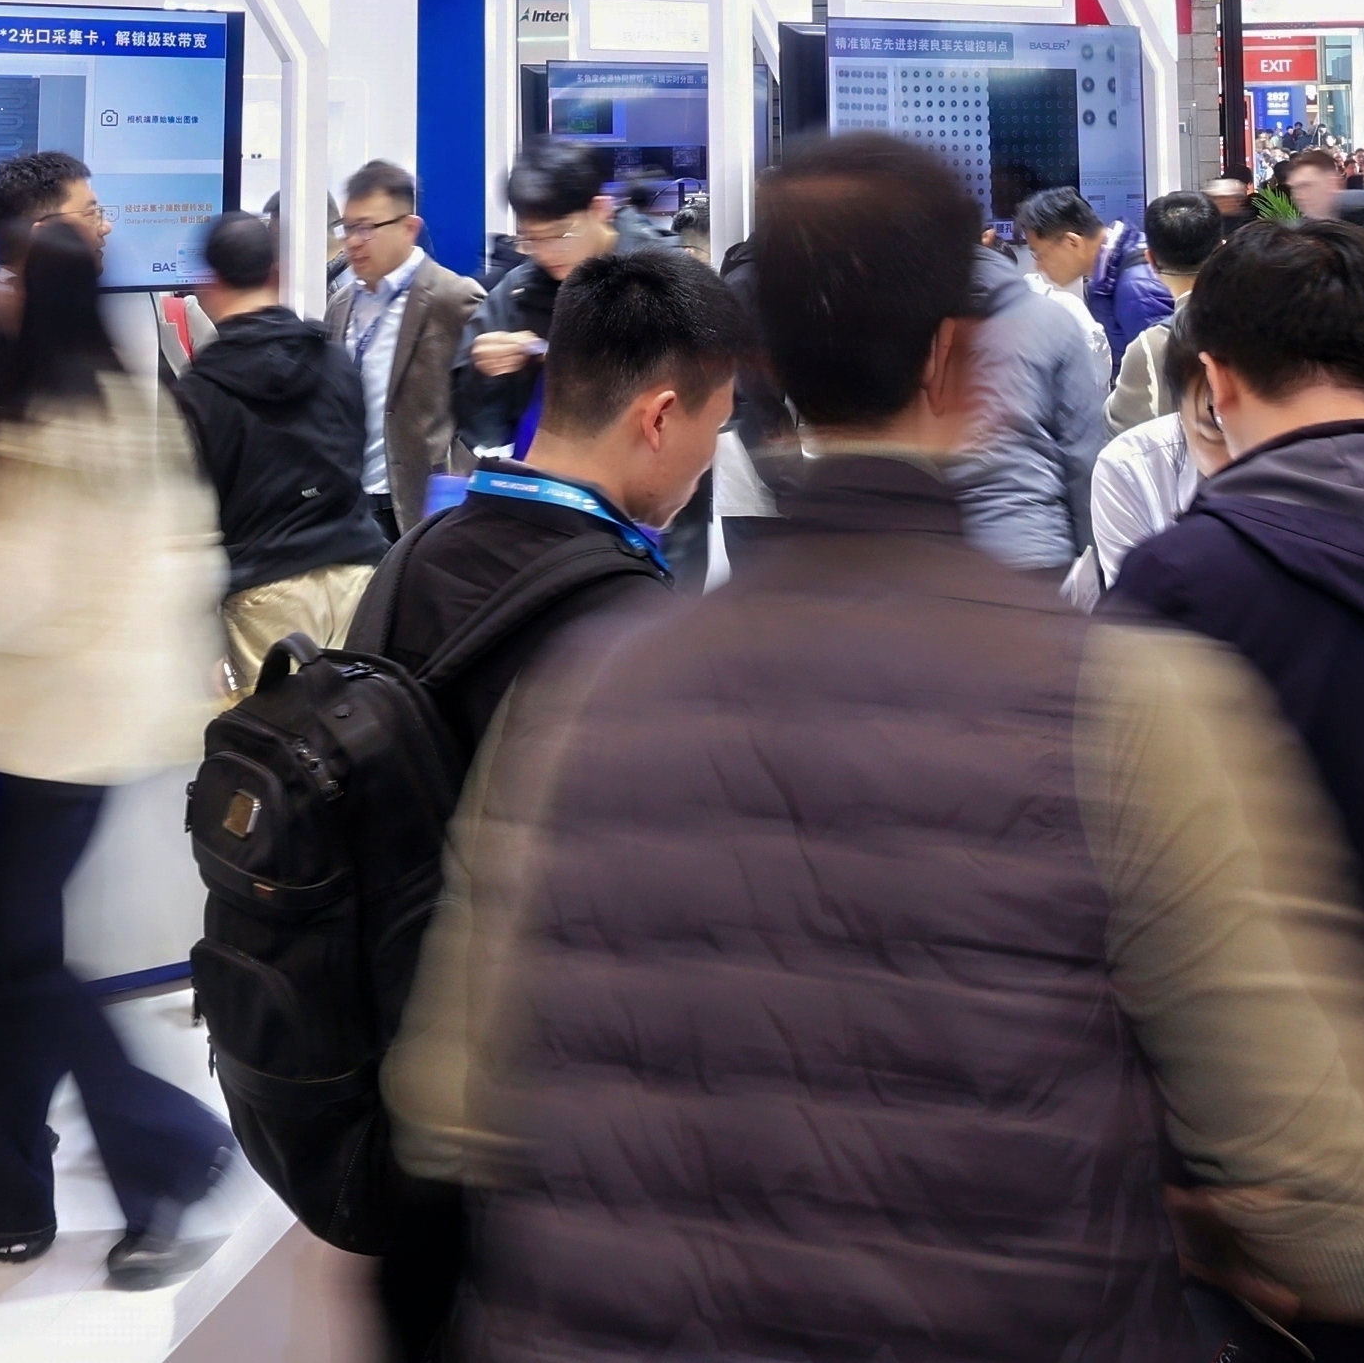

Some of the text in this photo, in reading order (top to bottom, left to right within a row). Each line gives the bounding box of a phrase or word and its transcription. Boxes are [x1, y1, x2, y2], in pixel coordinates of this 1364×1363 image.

[835, 36, 1009, 53] 精准锁定先进封装良率关键控制点
[1029, 41, 1066, 51] BASLER
[1260, 59, 1293, 73] EXIT
[152, 263, 177, 272] BAS
